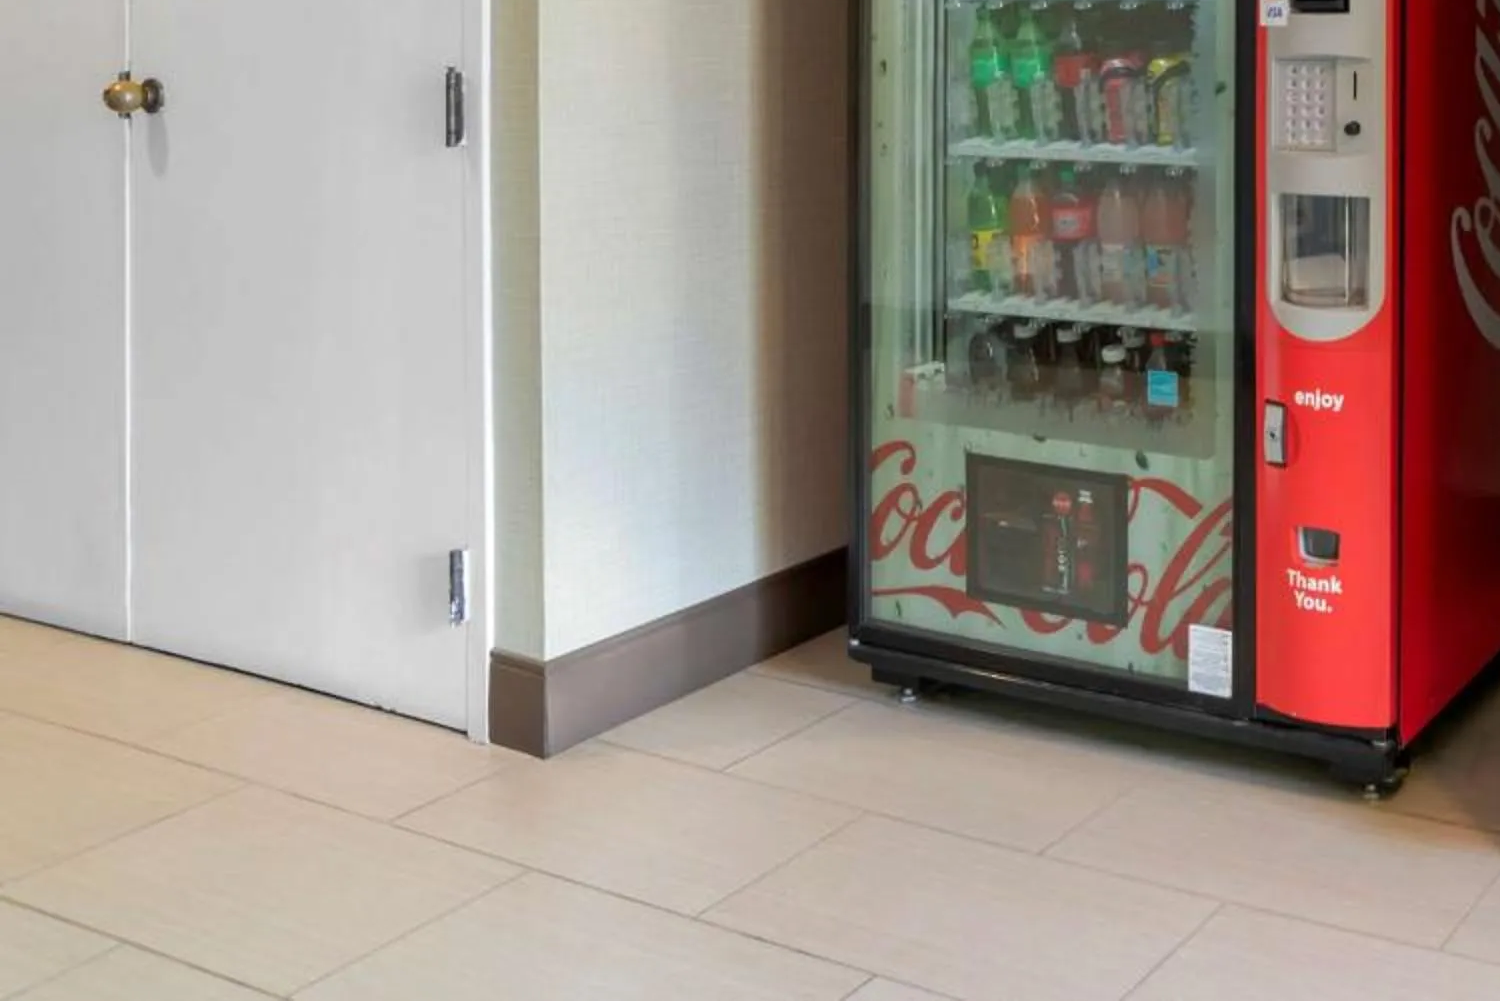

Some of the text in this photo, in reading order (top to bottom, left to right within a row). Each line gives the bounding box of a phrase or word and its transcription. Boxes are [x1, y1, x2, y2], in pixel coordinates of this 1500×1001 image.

[1294, 387, 1344, 412] enjoy
[1286, 567, 1343, 594] Thank
[1294, 590, 1333, 614] You.
